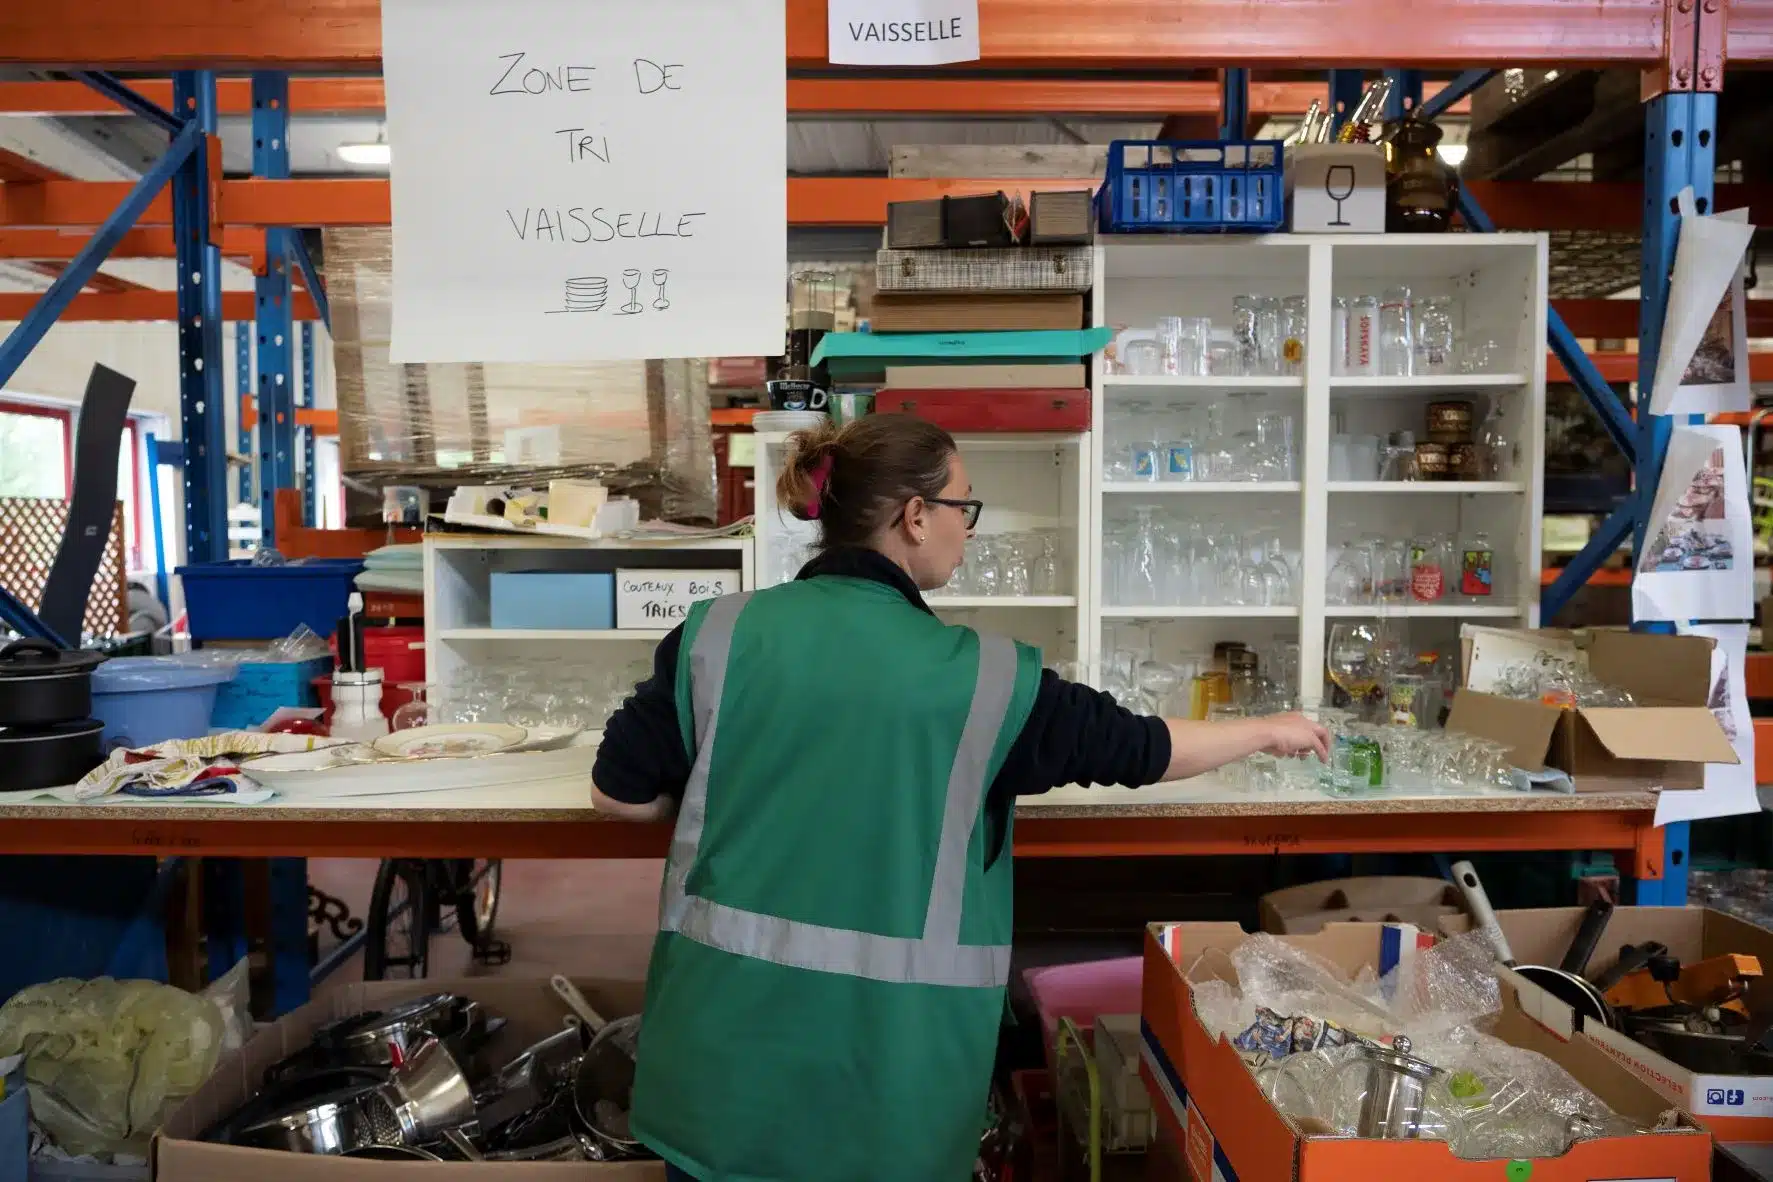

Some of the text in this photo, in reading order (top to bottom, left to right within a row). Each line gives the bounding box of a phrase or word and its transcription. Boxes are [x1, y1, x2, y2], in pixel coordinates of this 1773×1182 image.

[849, 17, 961, 42] VAISSELLE
[490, 52, 684, 95] ZONE DE
[555, 128, 610, 163] TRI
[506, 206, 706, 243] VAISSELLE
[623, 580, 675, 597] COUTEAUX
